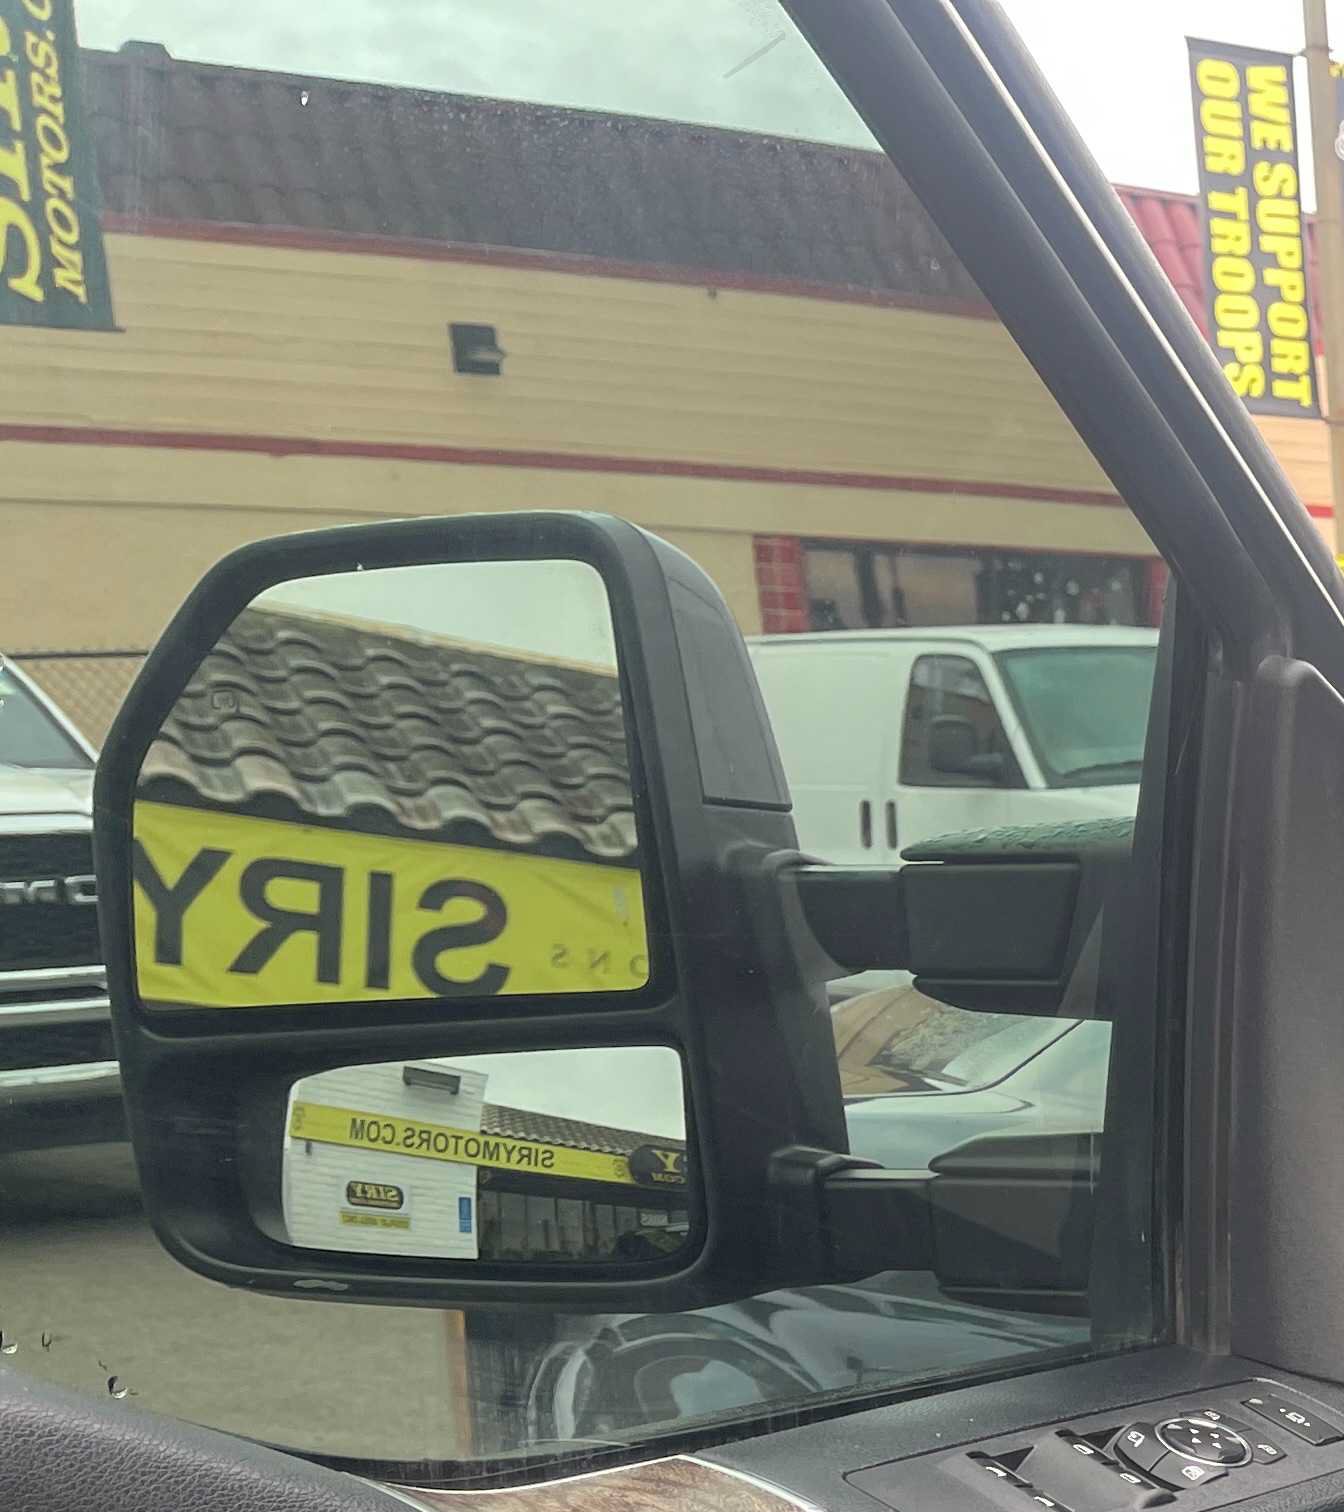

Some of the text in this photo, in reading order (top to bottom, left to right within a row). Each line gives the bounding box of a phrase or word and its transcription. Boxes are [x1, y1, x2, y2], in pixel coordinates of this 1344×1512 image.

[1196, 58, 1266, 399] OUR TROOPS
[1245, 64, 1314, 407] WE SUPPORT
